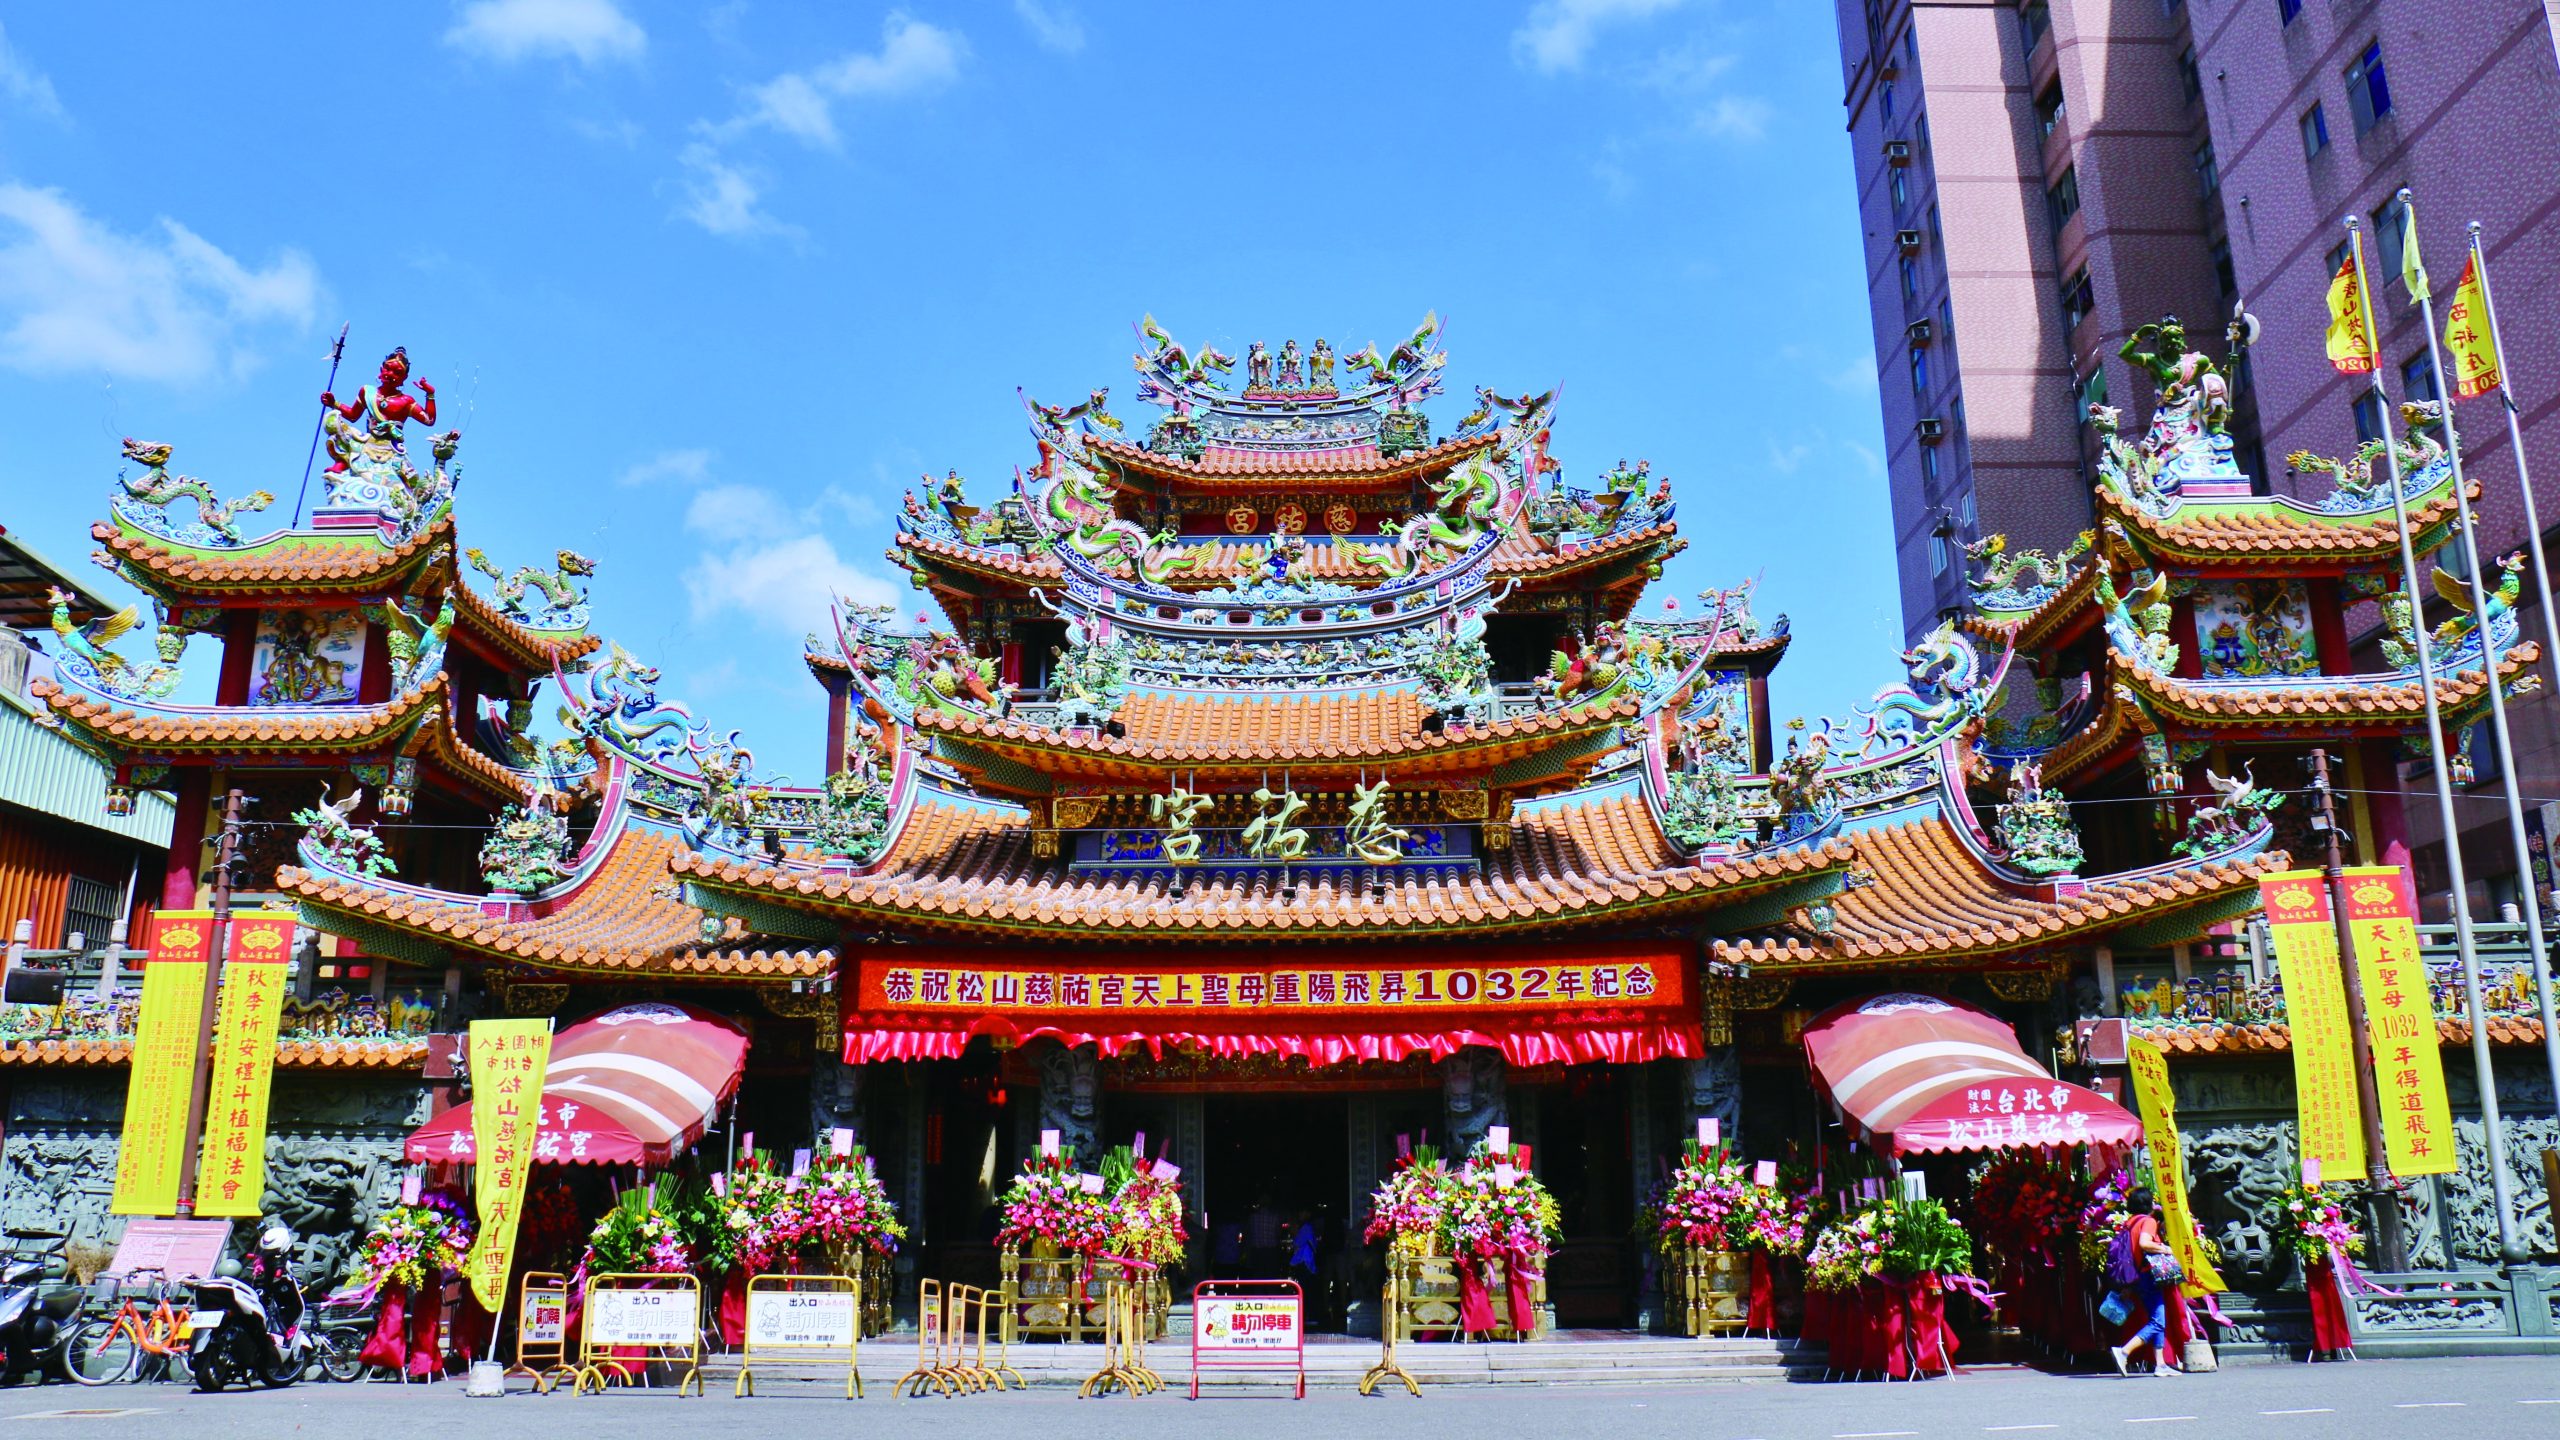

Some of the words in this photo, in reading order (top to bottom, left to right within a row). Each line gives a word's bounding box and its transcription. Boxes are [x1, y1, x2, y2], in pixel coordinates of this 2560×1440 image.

[2278, 910, 2319, 920] 松山慈祐宮
[2354, 906, 2398, 916] 松山慈祐宮
[157, 950, 200, 960] 松山慈祐宮
[239, 950, 281, 960] 松山慈祐宮
[221, 969, 268, 1201] 秋季祈安禮斗植福法會
[1998, 1085, 2072, 1113] 台北市
[1946, 1111, 2090, 1142] 松山慈祐宮
[632, 1296, 661, 1305] 出入口
[789, 1298, 817, 1307] 出入口
[1235, 1302, 1263, 1311] 出入口
[628, 1309, 690, 1331] 請勿停車
[785, 1311, 848, 1332] 請勿停車
[1231, 1313, 1292, 1335] 請勿停車
